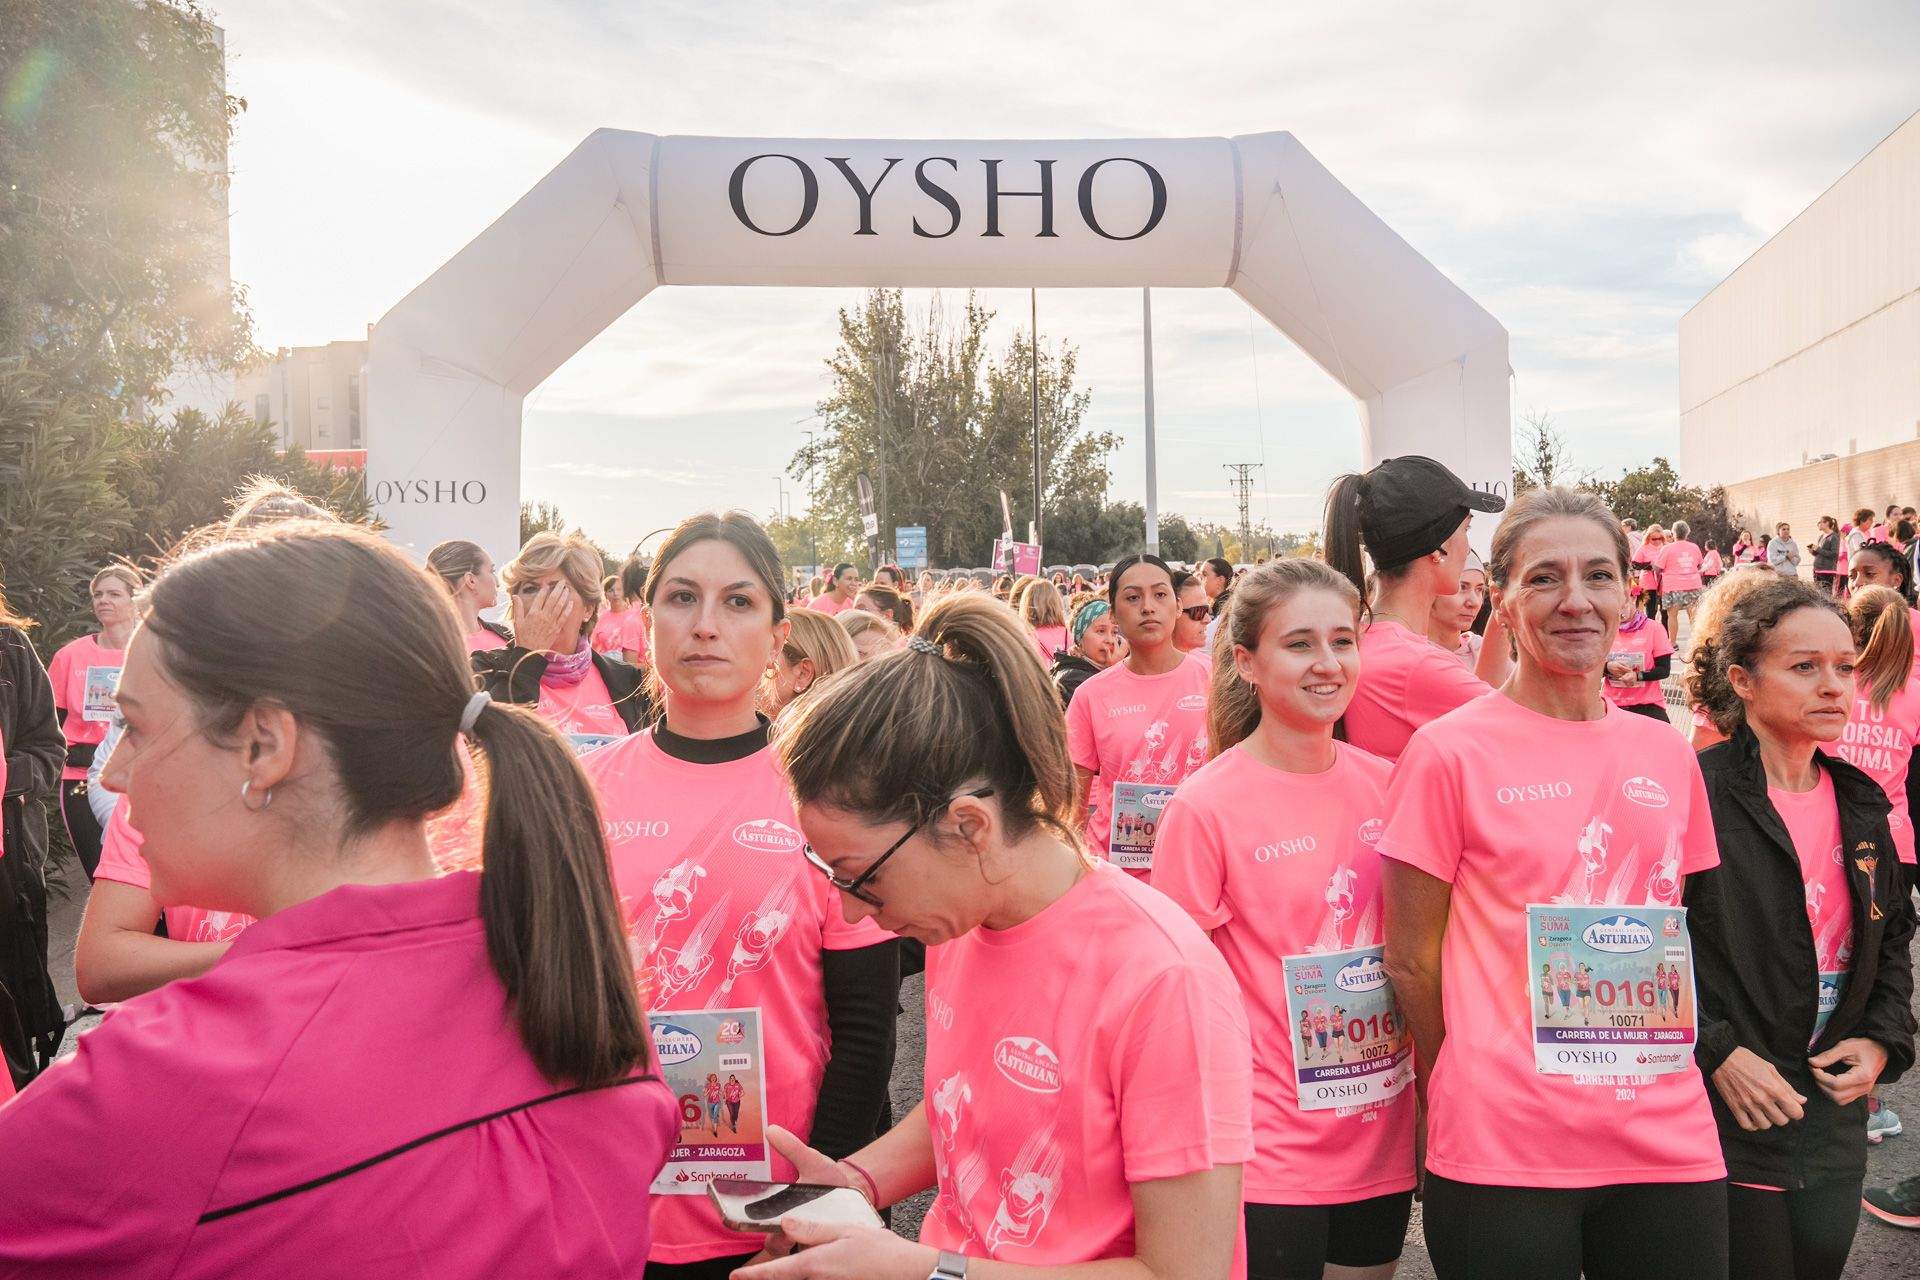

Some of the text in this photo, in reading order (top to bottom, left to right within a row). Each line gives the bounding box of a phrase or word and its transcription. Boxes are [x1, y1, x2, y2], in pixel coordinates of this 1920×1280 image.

[728, 153, 1168, 241] OYSHO
[375, 479, 487, 505] OYSHO
[1857, 699, 1884, 722] TU
[1842, 721, 1904, 750] ORSAL
[1837, 743, 1893, 772] SUMA
[1497, 780, 1572, 804] OYSHO
[738, 828, 798, 848] ASTURIANA
[1255, 834, 1317, 862] OYSHO
[1119, 855, 1150, 863] OYSHO
[1540, 921, 1570, 931] SUMA
[1587, 928, 1651, 944] ASTURIANA
[1295, 969, 1323, 981] SUMA
[1339, 970, 1388, 987] ASTURIAN
[1595, 979, 1655, 1007] 016
[1347, 1011, 1395, 1043] 016
[1609, 1014, 1645, 1027] 10071
[1556, 1030, 1685, 1040] CARRERA DE LA MUJER ZARAGOZA
[656, 1042, 697, 1055] RIANA
[1360, 1043, 1389, 1060] 10072
[1557, 1050, 1681, 1064] OYSHO Santander
[997, 1045, 1060, 1089] ASTURIANA
[1315, 1057, 1392, 1078] CARRERA DE LA MUJER
[1316, 1081, 1368, 1099] OYSHO
[1615, 1088, 1636, 1101] 2024
[698, 1147, 746, 1157] ZARAGOZA
